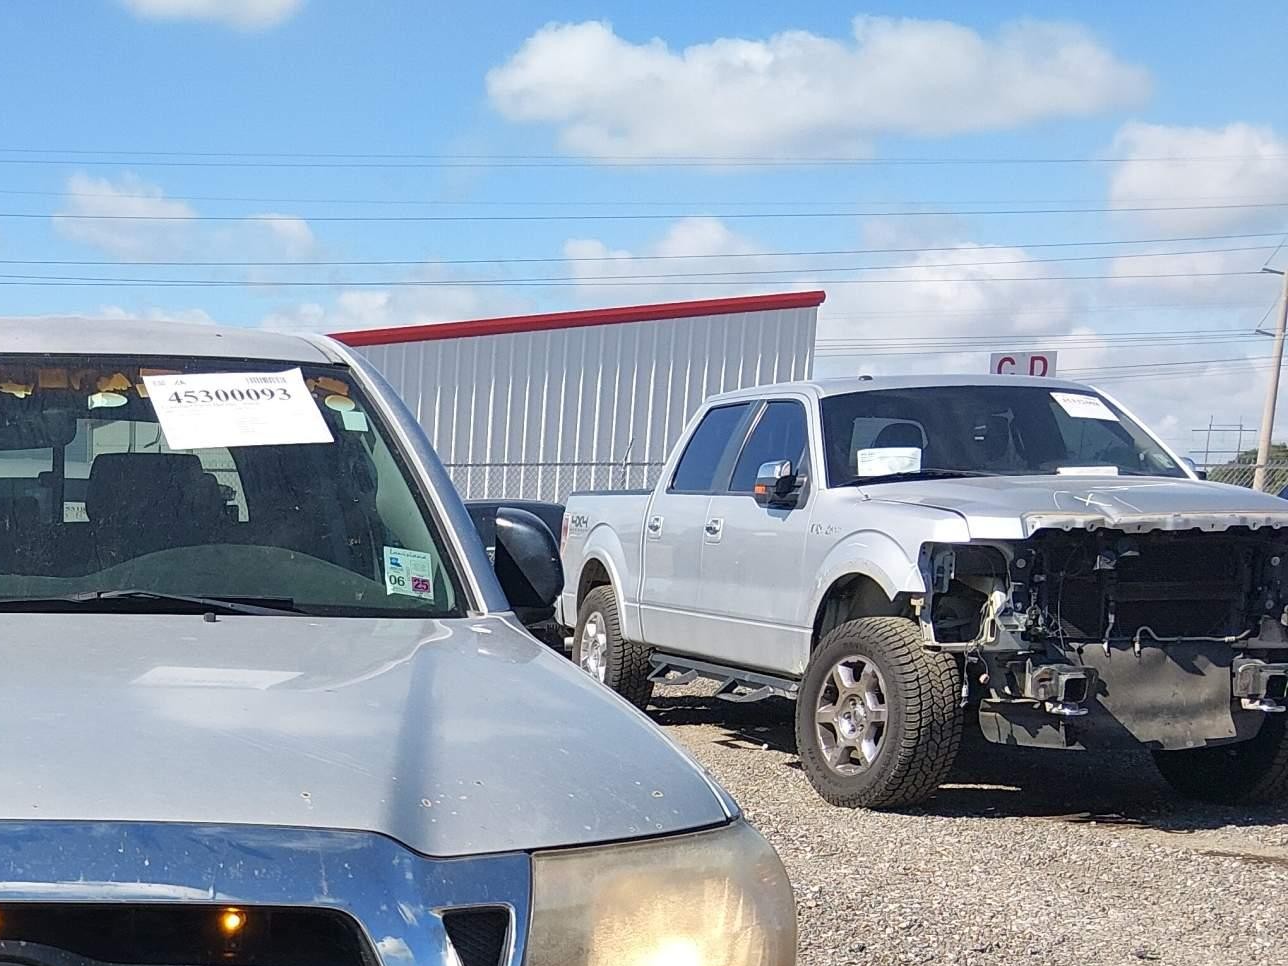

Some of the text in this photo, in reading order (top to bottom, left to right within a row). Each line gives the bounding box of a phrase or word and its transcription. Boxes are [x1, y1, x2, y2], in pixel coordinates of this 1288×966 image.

[997, 355, 1048, 377] C D
[168, 386, 292, 404] 45300093
[389, 574, 405, 587] 06
[412, 578, 429, 591] 25
